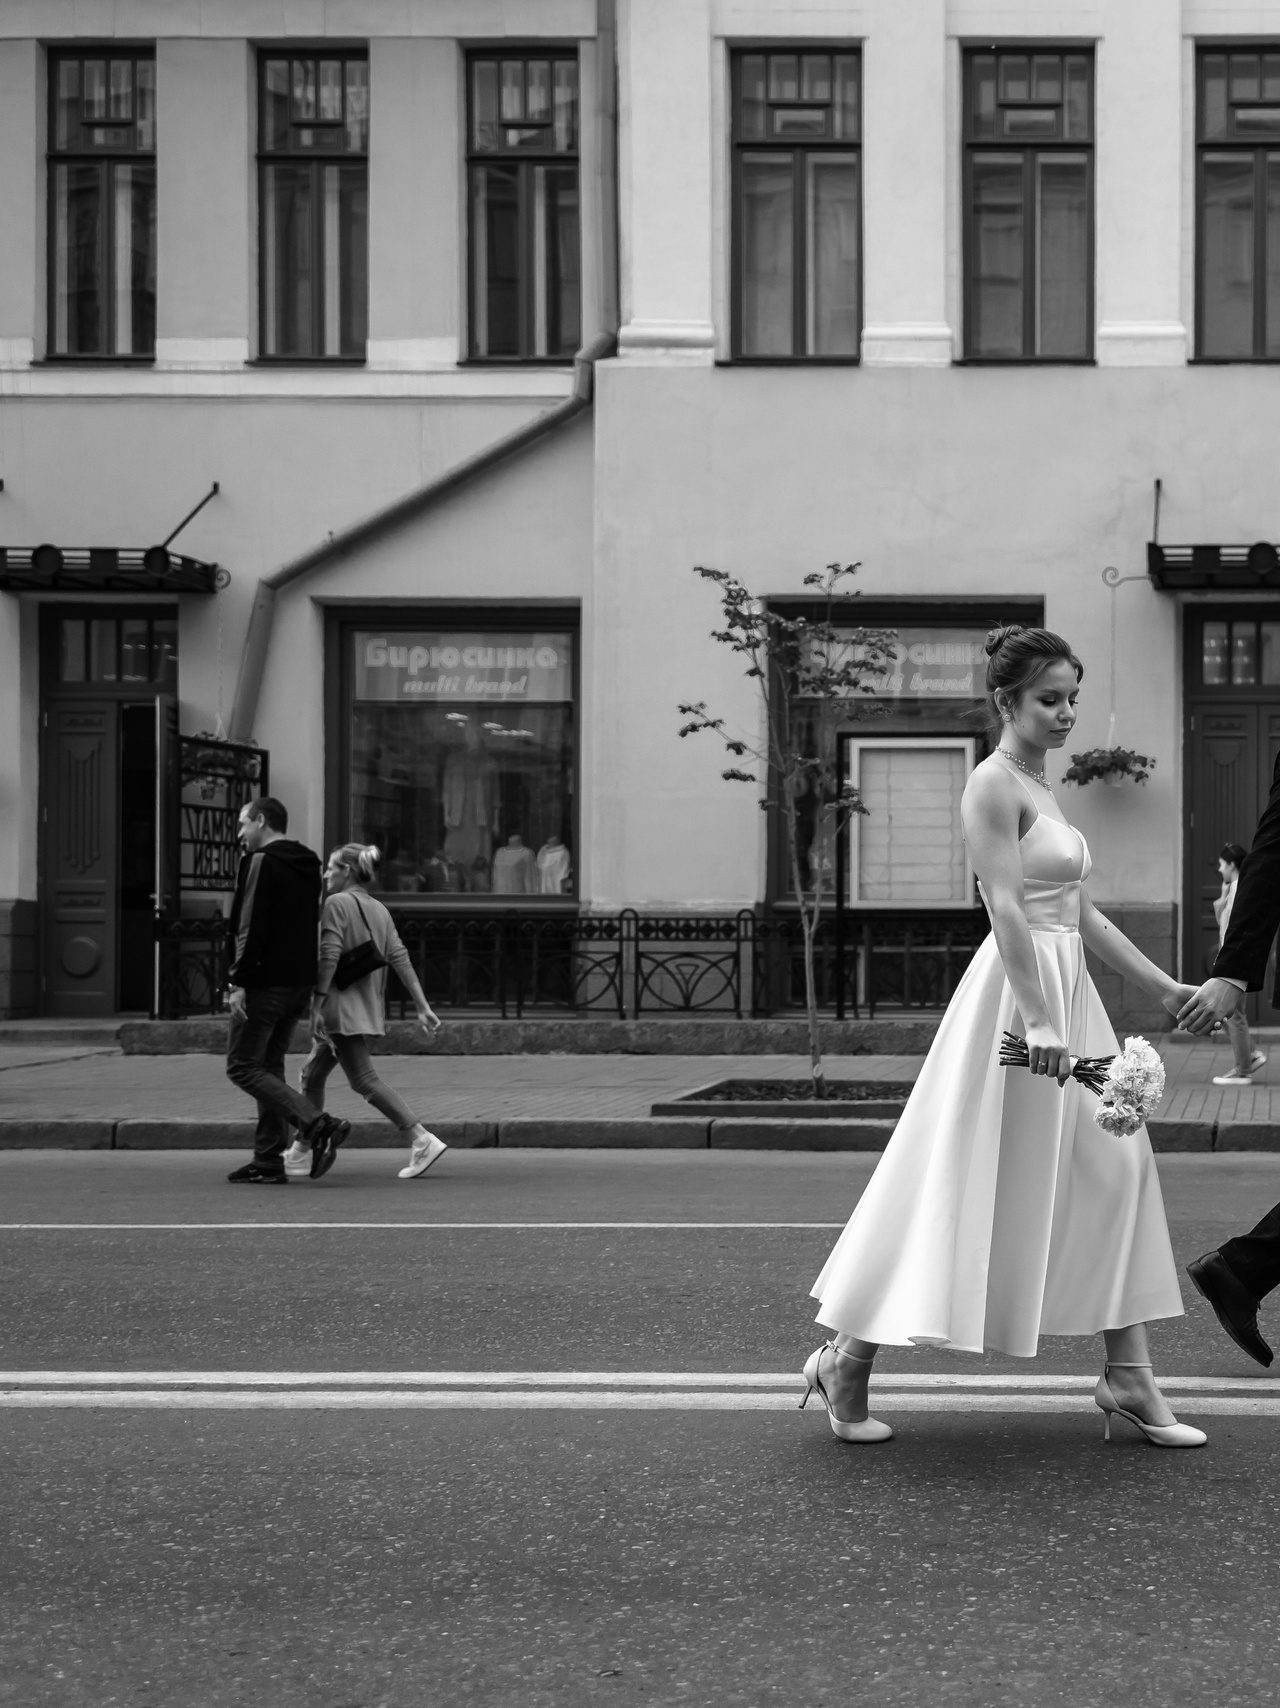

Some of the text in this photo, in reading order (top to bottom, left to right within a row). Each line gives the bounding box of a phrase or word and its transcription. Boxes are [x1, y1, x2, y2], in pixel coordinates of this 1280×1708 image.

[365, 638, 558, 675] Бирюсинка
[810, 638, 986, 667] Биюсинк
[403, 675, 527, 693] multi brand
[859, 672, 973, 691] ulti brand
